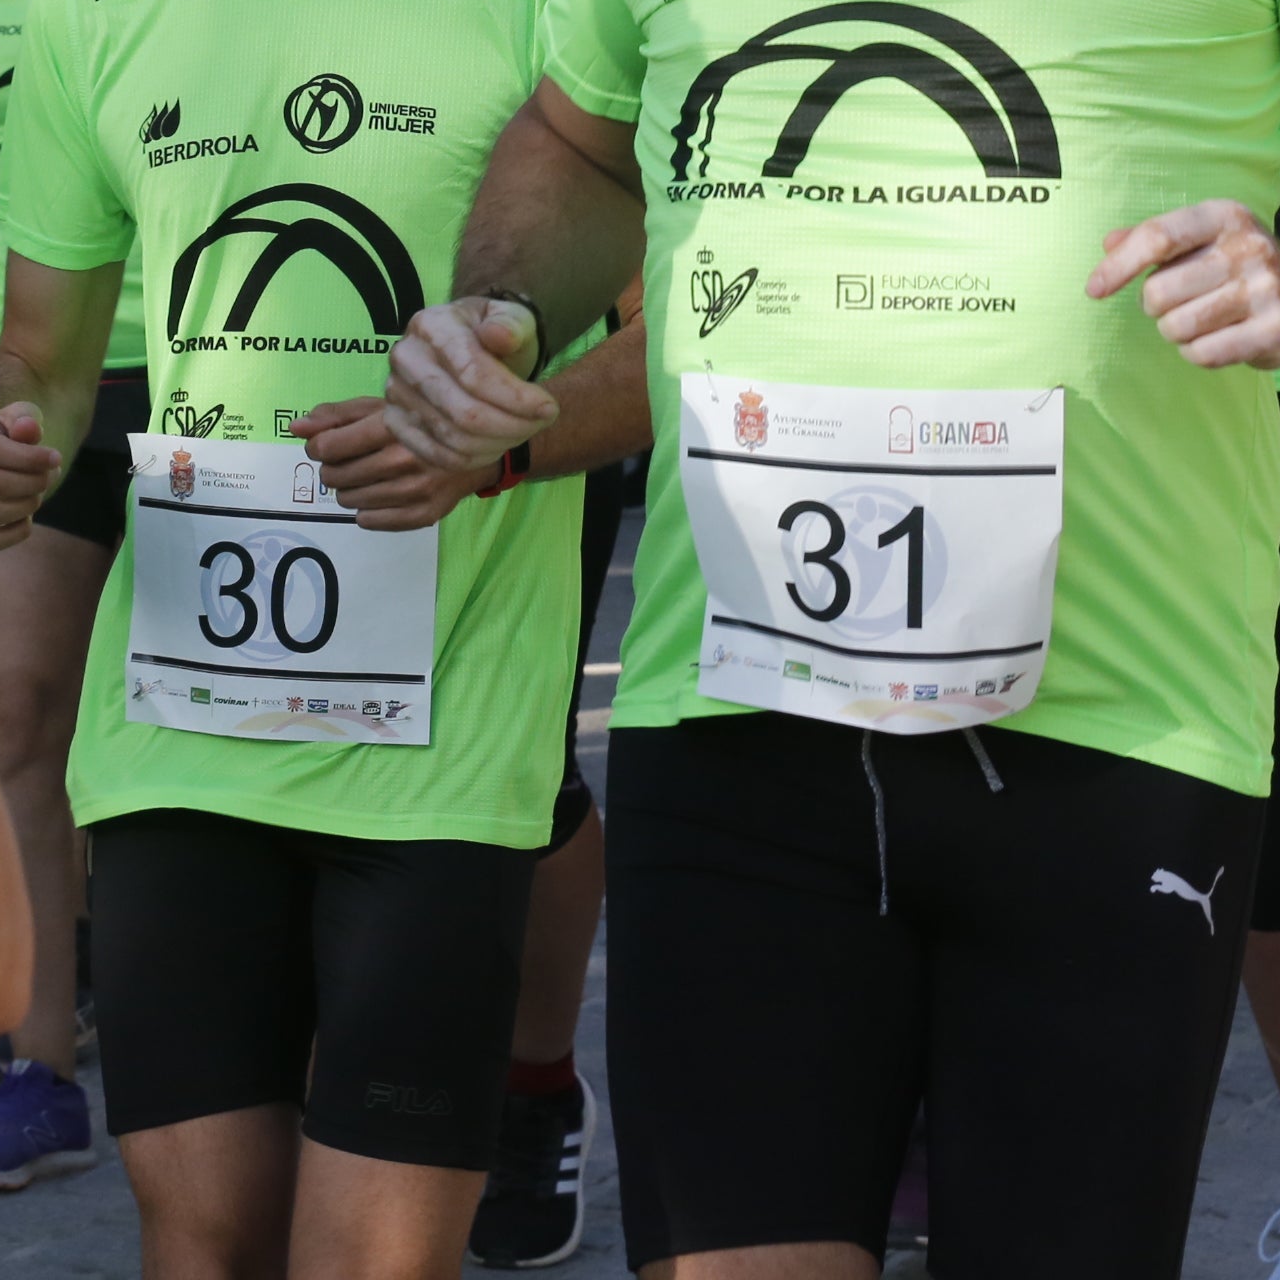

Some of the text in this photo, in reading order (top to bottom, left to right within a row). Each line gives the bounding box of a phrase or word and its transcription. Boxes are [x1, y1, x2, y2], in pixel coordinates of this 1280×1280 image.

[369, 102, 437, 118] UNIVERSO
[368, 116, 435, 136] MUJER
[148, 134, 259, 169] IBERDROLA
[686, 183, 766, 201] FORMA
[852, 186, 889, 204] LA
[756, 279, 787, 290] Consejo
[881, 273, 990, 291] FUNDACIÓN
[756, 292, 801, 303] Superior de
[881, 296, 1015, 312] DEPORTE JOVEN
[756, 304, 791, 315] Deportes
[171, 336, 228, 354] ORMA
[284, 337, 307, 353] LA
[312, 336, 400, 354] IGUALD
[222, 413, 244, 423] Consejo
[222, 424, 255, 433] Superior de
[919, 421, 1009, 446] GRANADA
[222, 433, 248, 442] Deportes
[777, 500, 925, 629] 31
[197, 541, 340, 654] 30
[333, 703, 357, 711] IDEAL
